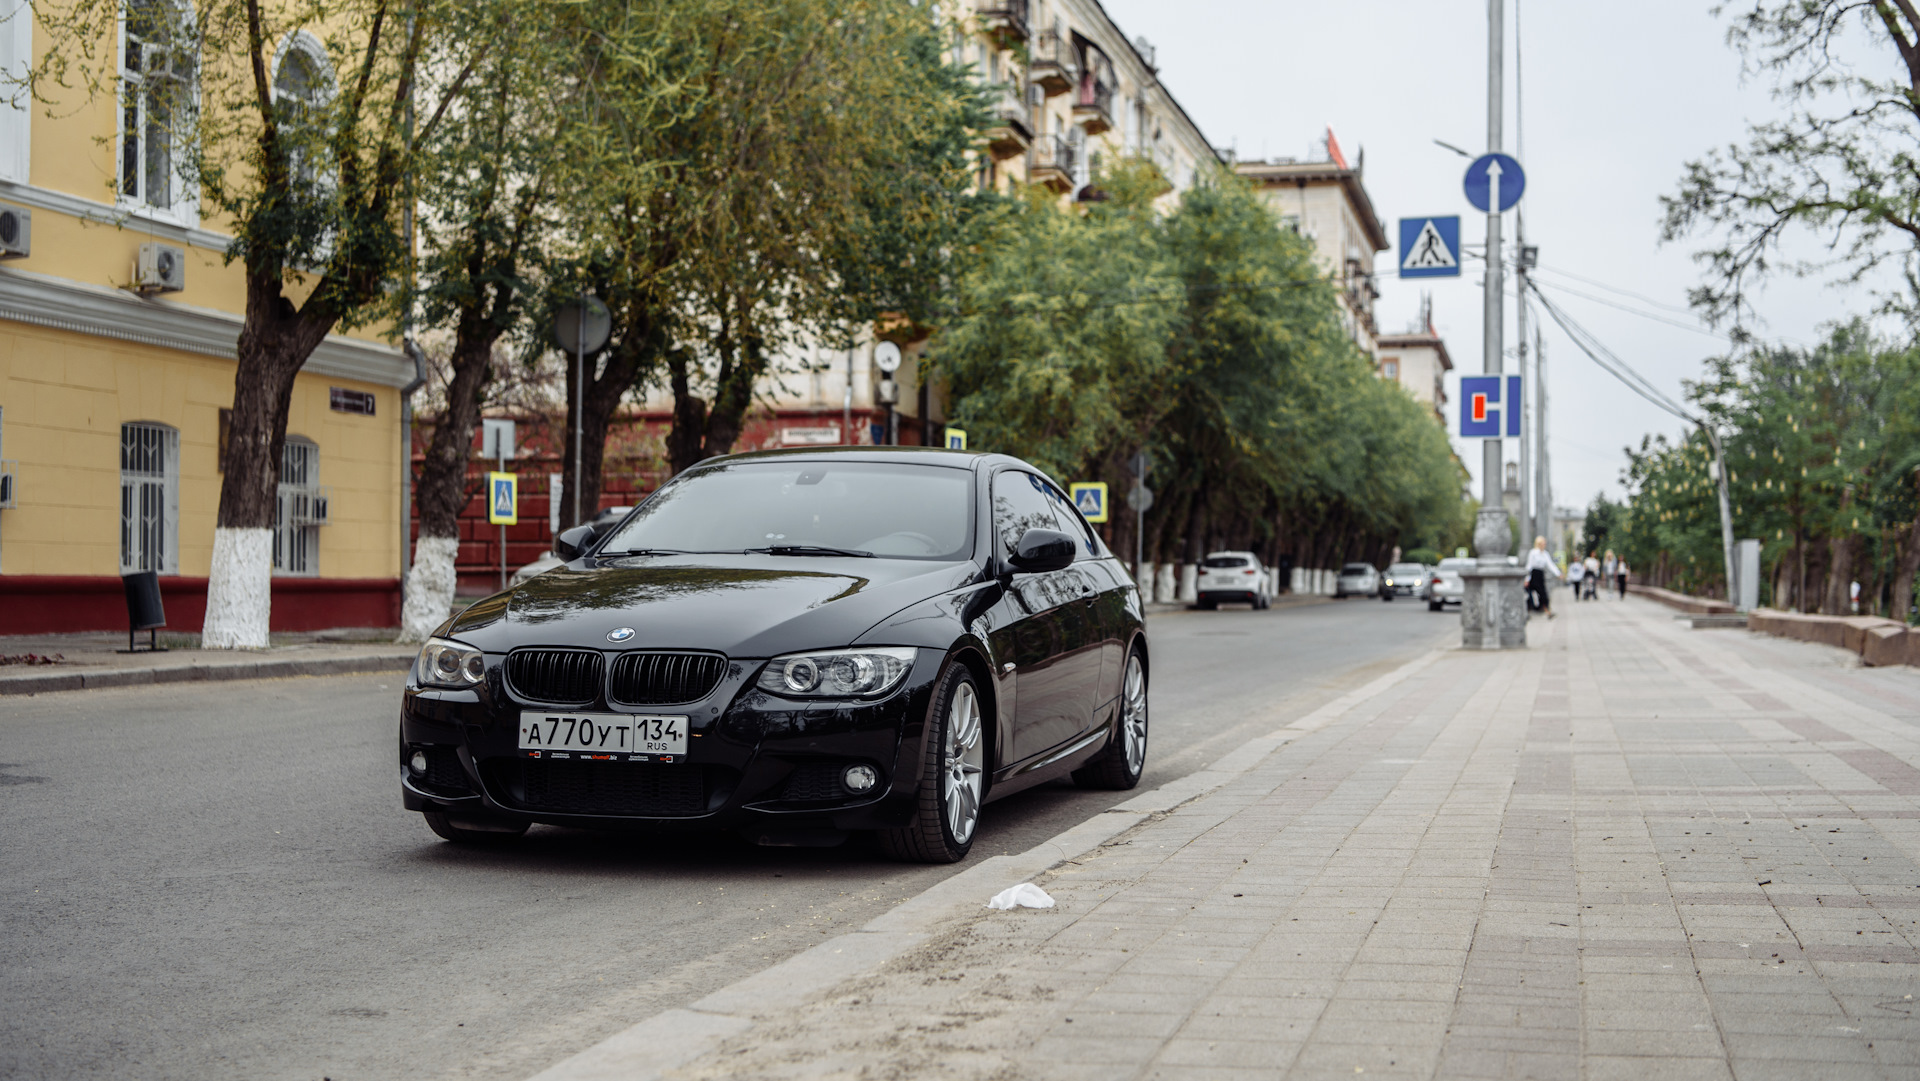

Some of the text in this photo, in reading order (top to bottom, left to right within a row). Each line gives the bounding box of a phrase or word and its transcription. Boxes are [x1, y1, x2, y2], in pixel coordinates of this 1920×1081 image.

[367, 396, 373, 412] 7
[637, 719, 677, 741] 134
[647, 742, 668, 751] RUS
